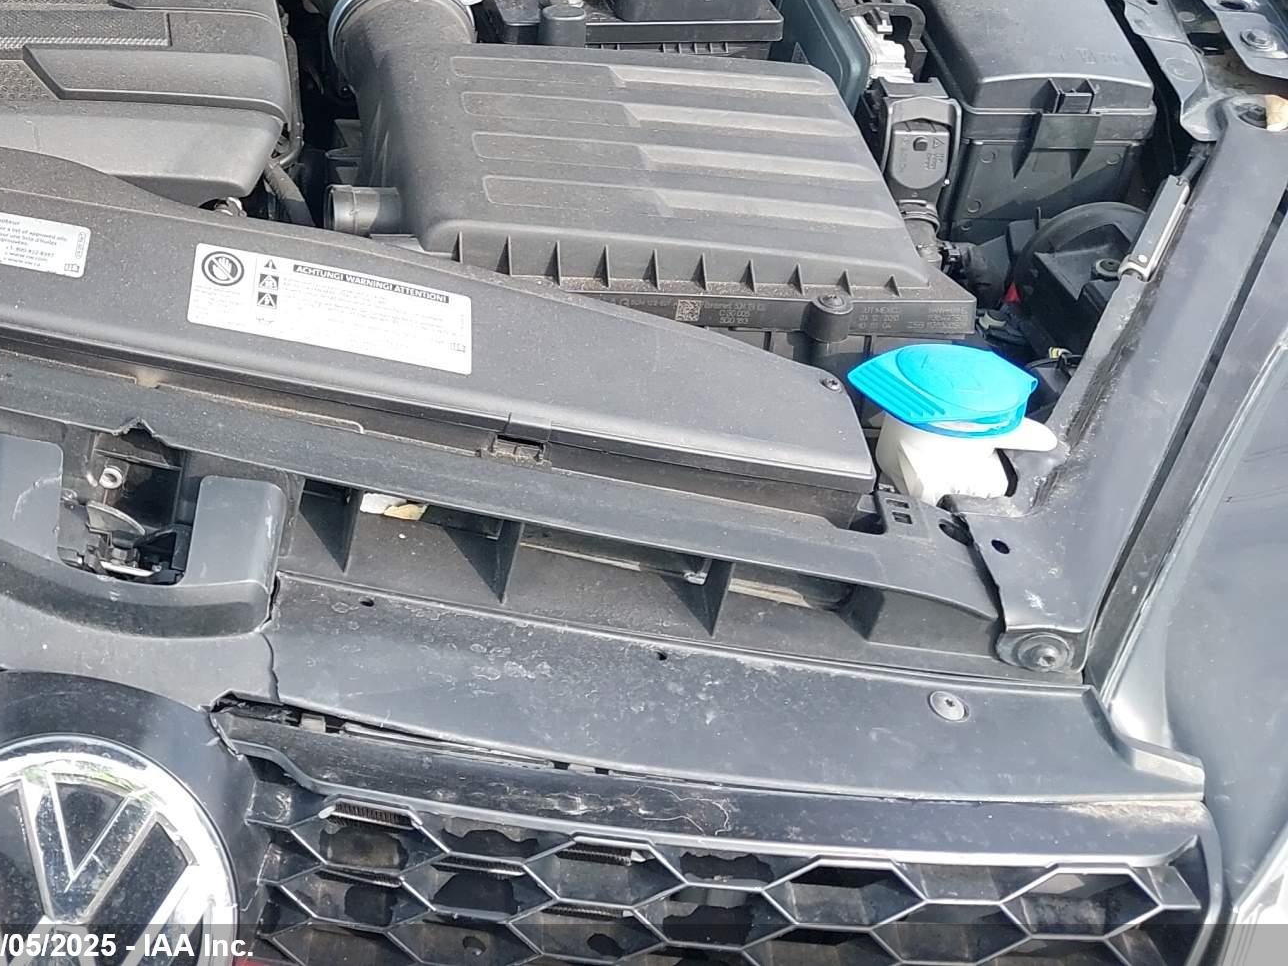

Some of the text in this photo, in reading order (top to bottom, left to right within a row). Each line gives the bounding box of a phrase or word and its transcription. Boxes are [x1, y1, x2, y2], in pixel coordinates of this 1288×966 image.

[296, 265, 447, 303] ACHTUNG! WARNING! ATTENTION!
